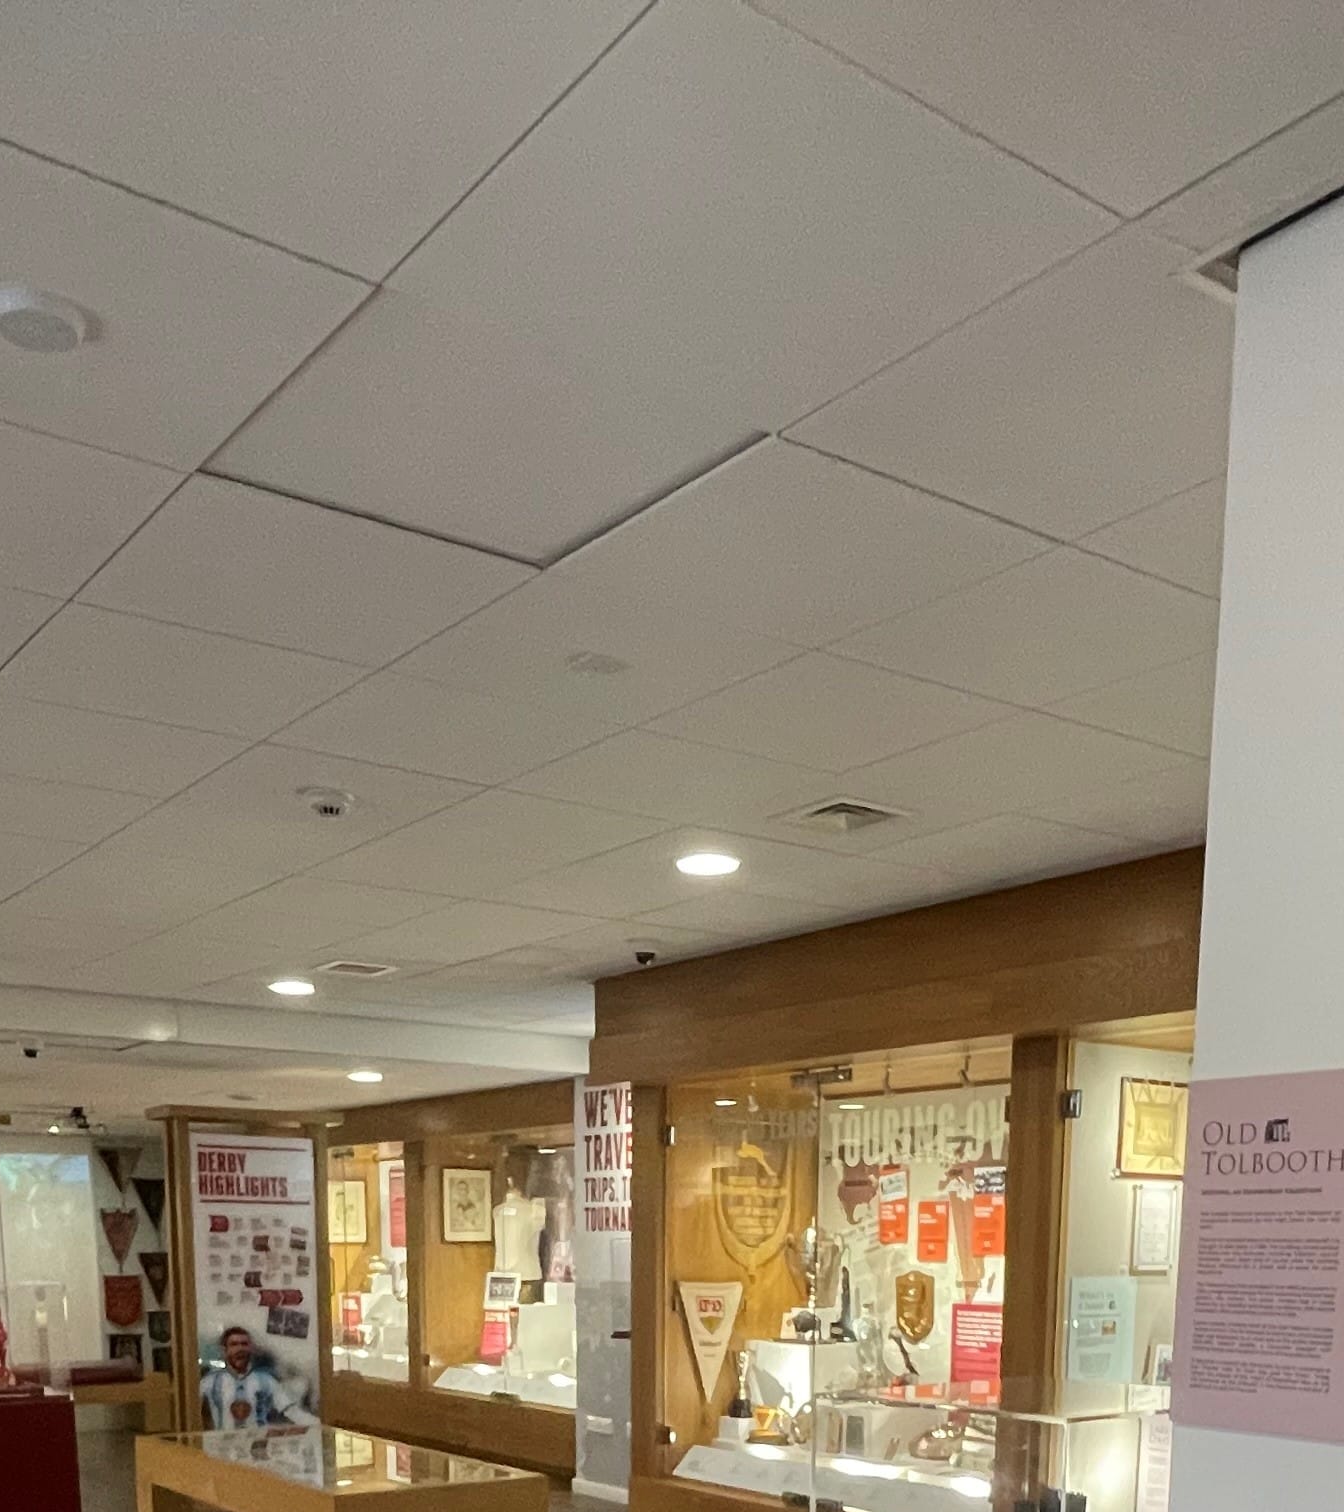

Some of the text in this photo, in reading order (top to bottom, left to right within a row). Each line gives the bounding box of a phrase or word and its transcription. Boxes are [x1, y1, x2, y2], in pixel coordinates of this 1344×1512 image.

[1202, 1120, 1258, 1147] OLD
[197, 1151, 247, 1174] DERBY
[198, 1174, 289, 1198] HIGHLIGHTS
